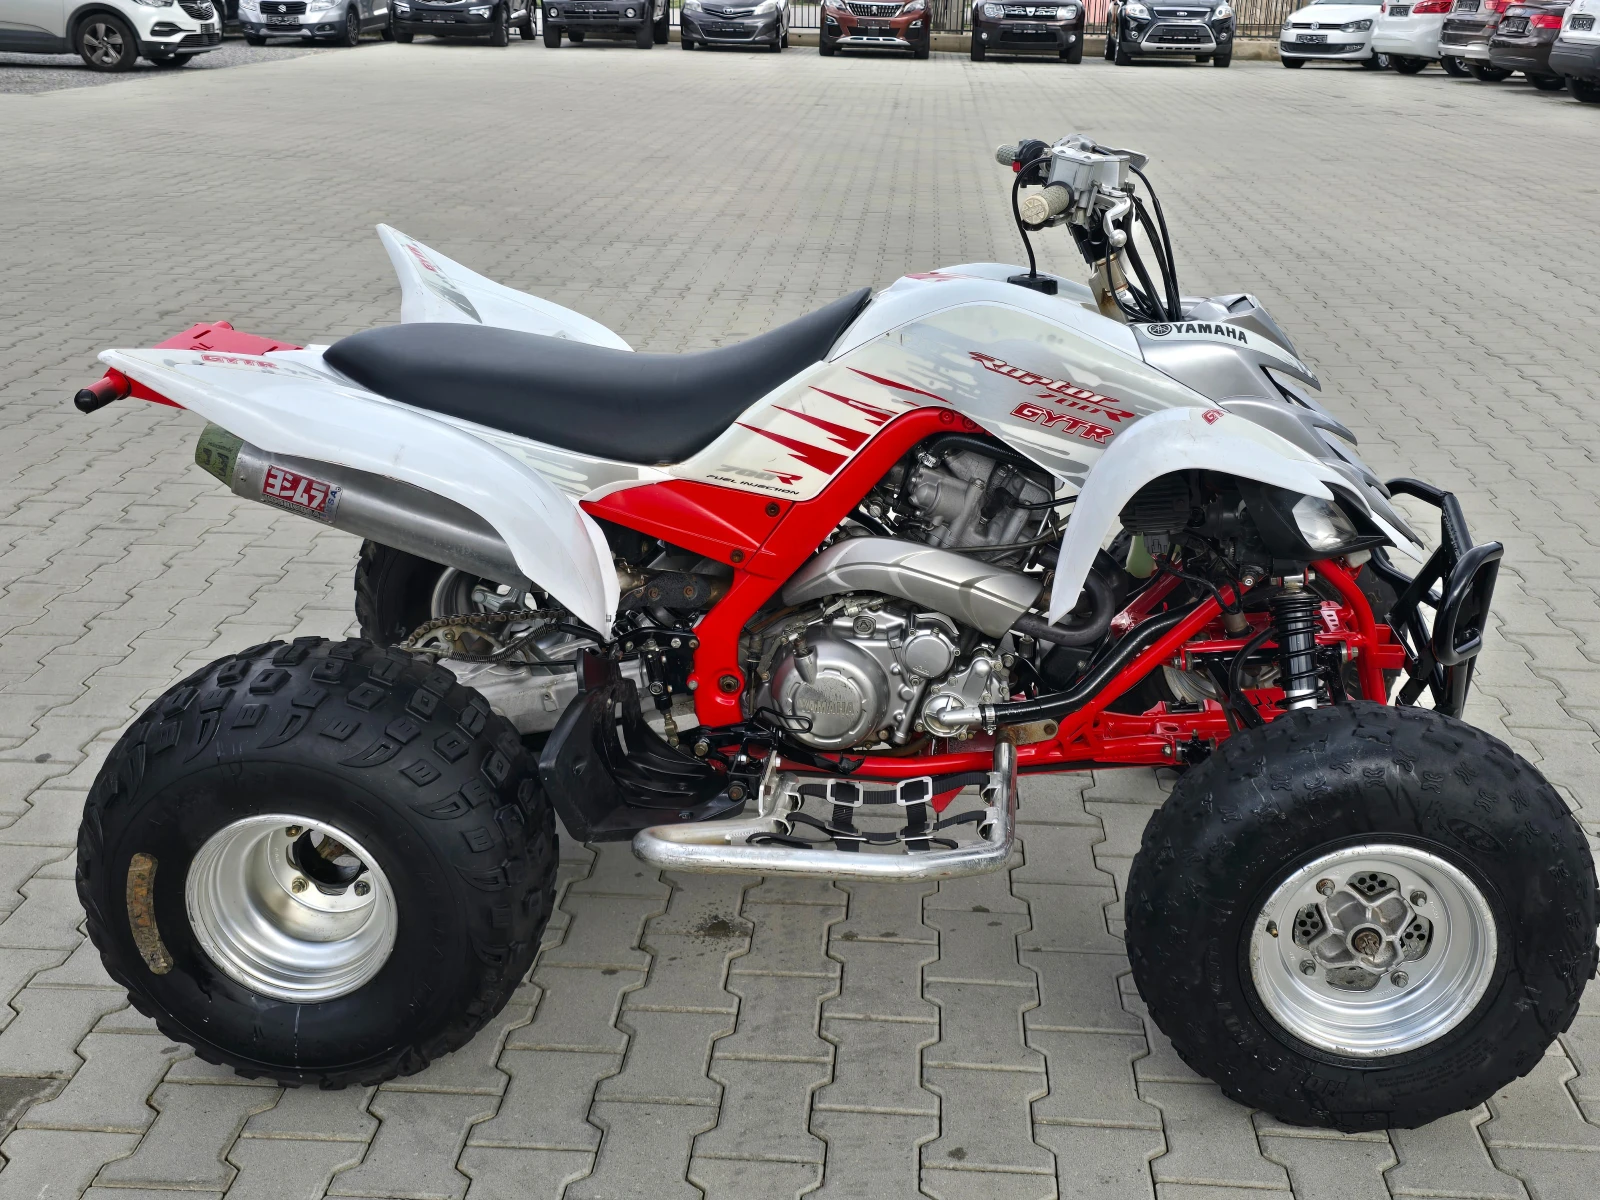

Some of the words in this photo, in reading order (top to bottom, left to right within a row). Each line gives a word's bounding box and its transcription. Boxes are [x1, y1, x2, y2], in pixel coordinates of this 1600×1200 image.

[1173, 323, 1248, 344] YAMAHA
[201, 354, 279, 369] GYTR
[1010, 401, 1115, 444] GYTR
[706, 474, 737, 484] FUEL
[739, 481, 800, 495] INJECTION
[715, 464, 803, 485] 700R
[266, 469, 325, 509] ヨシムラ
[800, 699, 854, 716] YAMAHA
